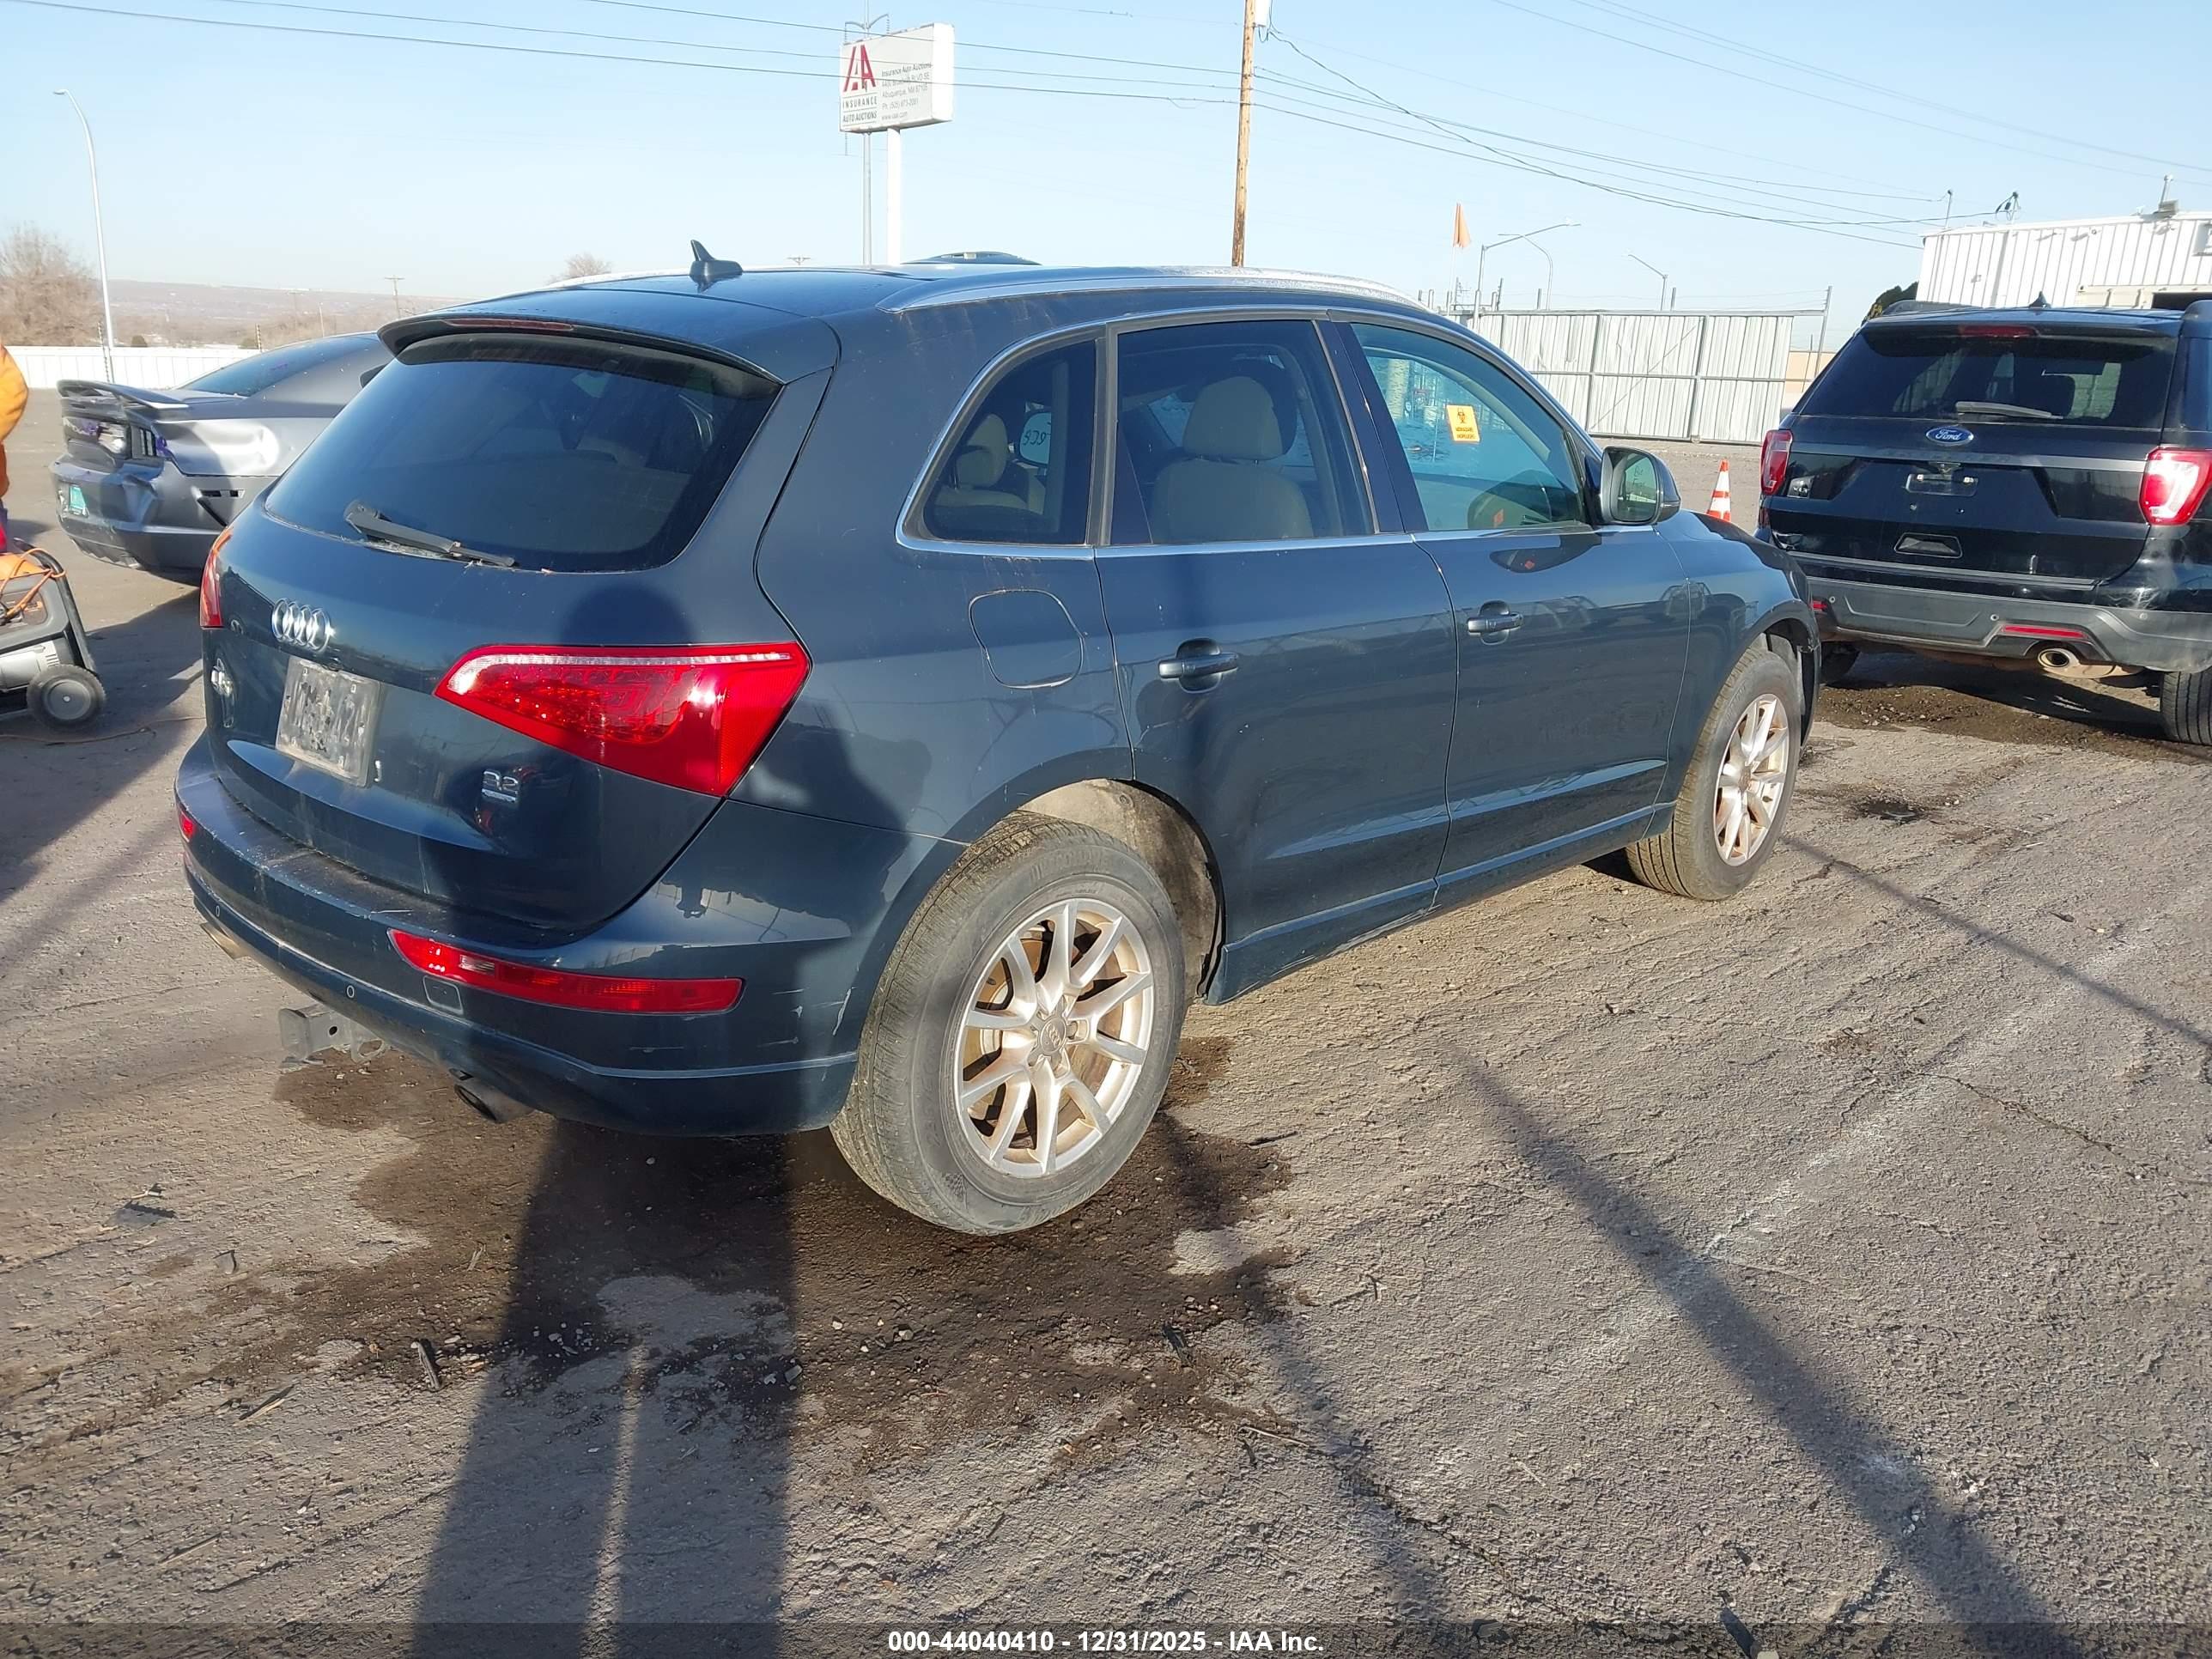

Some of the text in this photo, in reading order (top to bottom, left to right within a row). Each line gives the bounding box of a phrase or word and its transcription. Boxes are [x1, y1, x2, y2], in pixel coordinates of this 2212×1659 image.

[842, 95, 878, 110] INSURANCE
[842, 111, 878, 123] AUTO AUCTIONS
[1935, 428, 1963, 441] Ford
